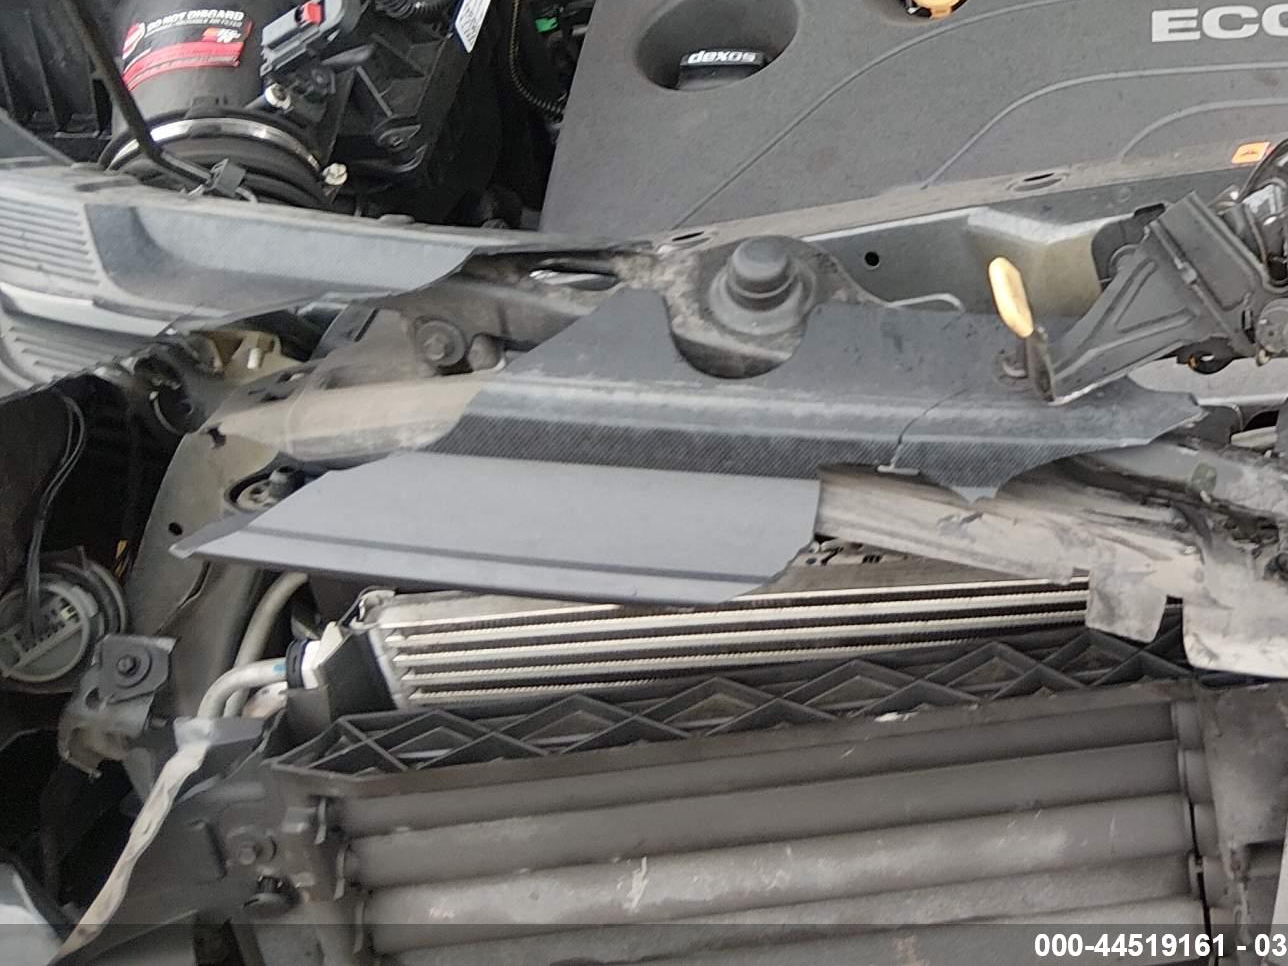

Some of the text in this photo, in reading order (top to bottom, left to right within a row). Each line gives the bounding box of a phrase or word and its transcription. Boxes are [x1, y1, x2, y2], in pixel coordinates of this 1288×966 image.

[163, 12, 187, 26] NOT
[187, 9, 245, 22] DISCARD
[687, 50, 756, 64] dexos
